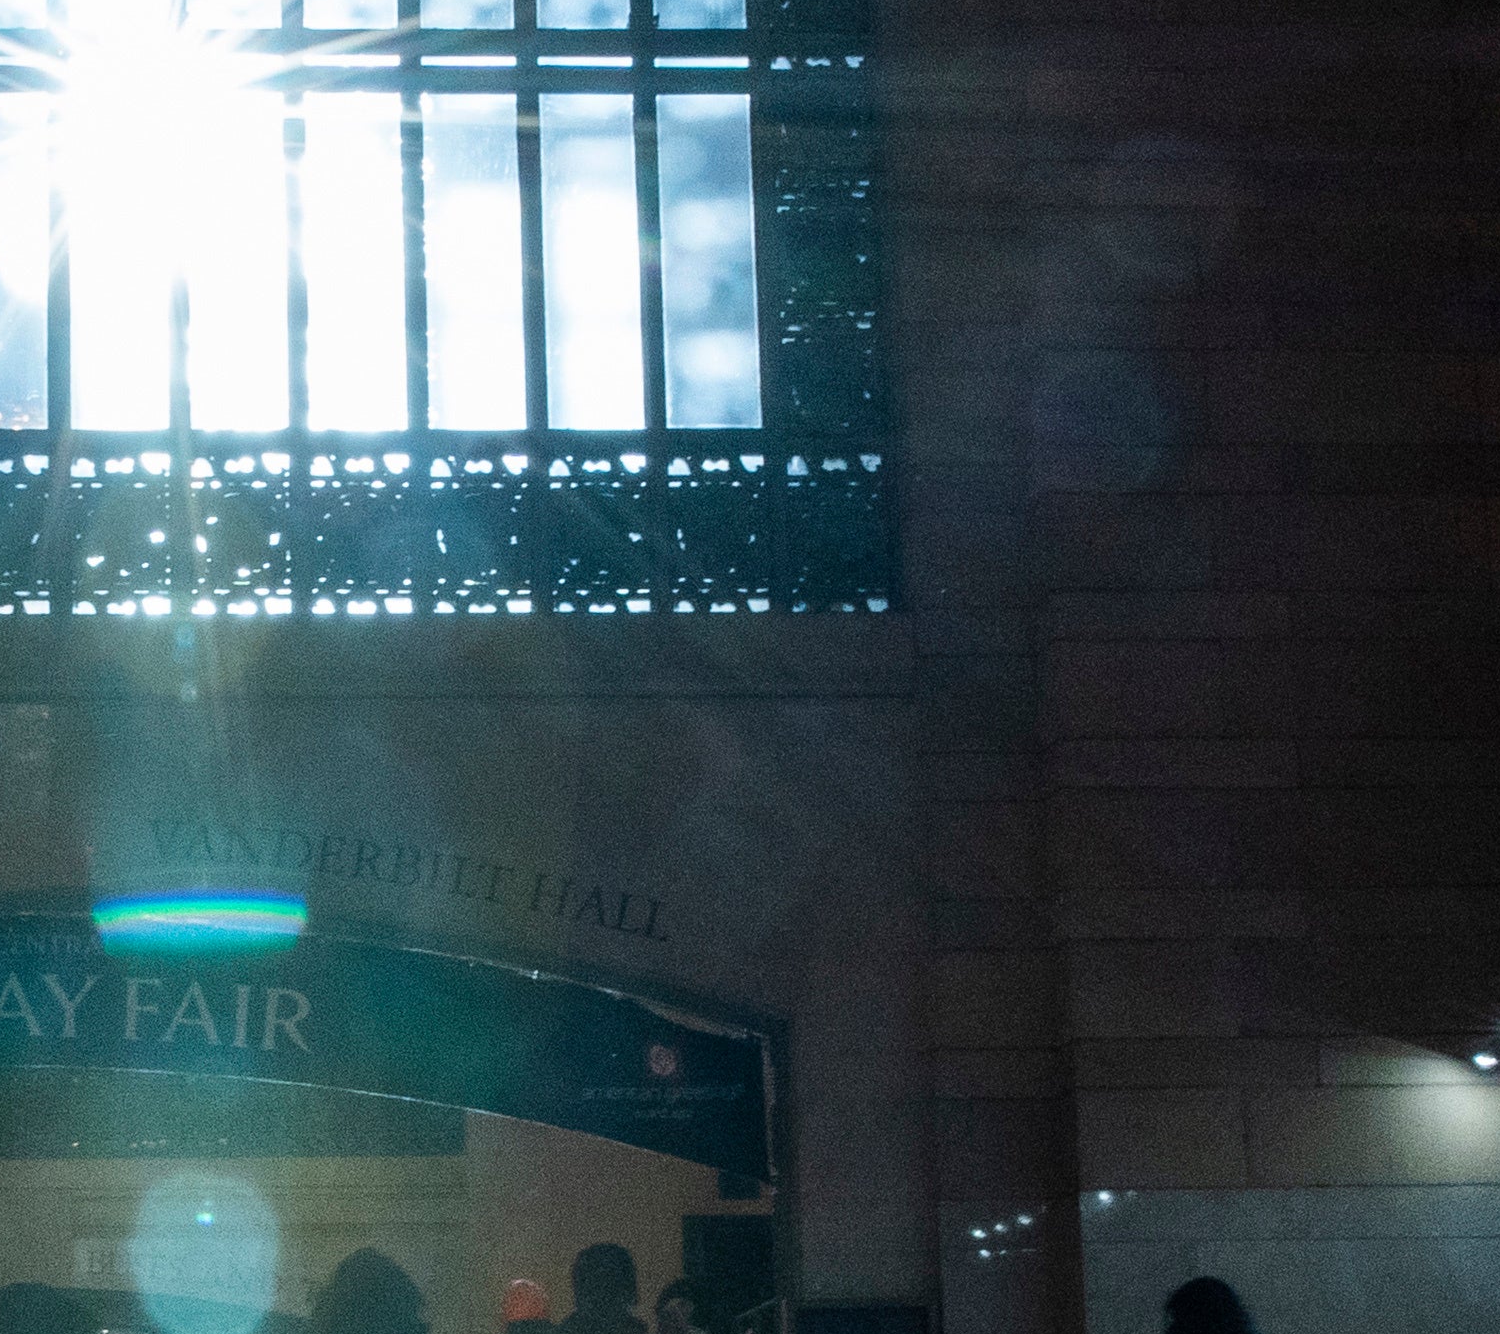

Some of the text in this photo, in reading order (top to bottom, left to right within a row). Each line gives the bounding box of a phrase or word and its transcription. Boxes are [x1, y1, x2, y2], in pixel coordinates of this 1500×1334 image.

[148, 819, 514, 904] VANDERBILT
[528, 873, 669, 942] HALL
[121, 977, 313, 1053] FAIR
